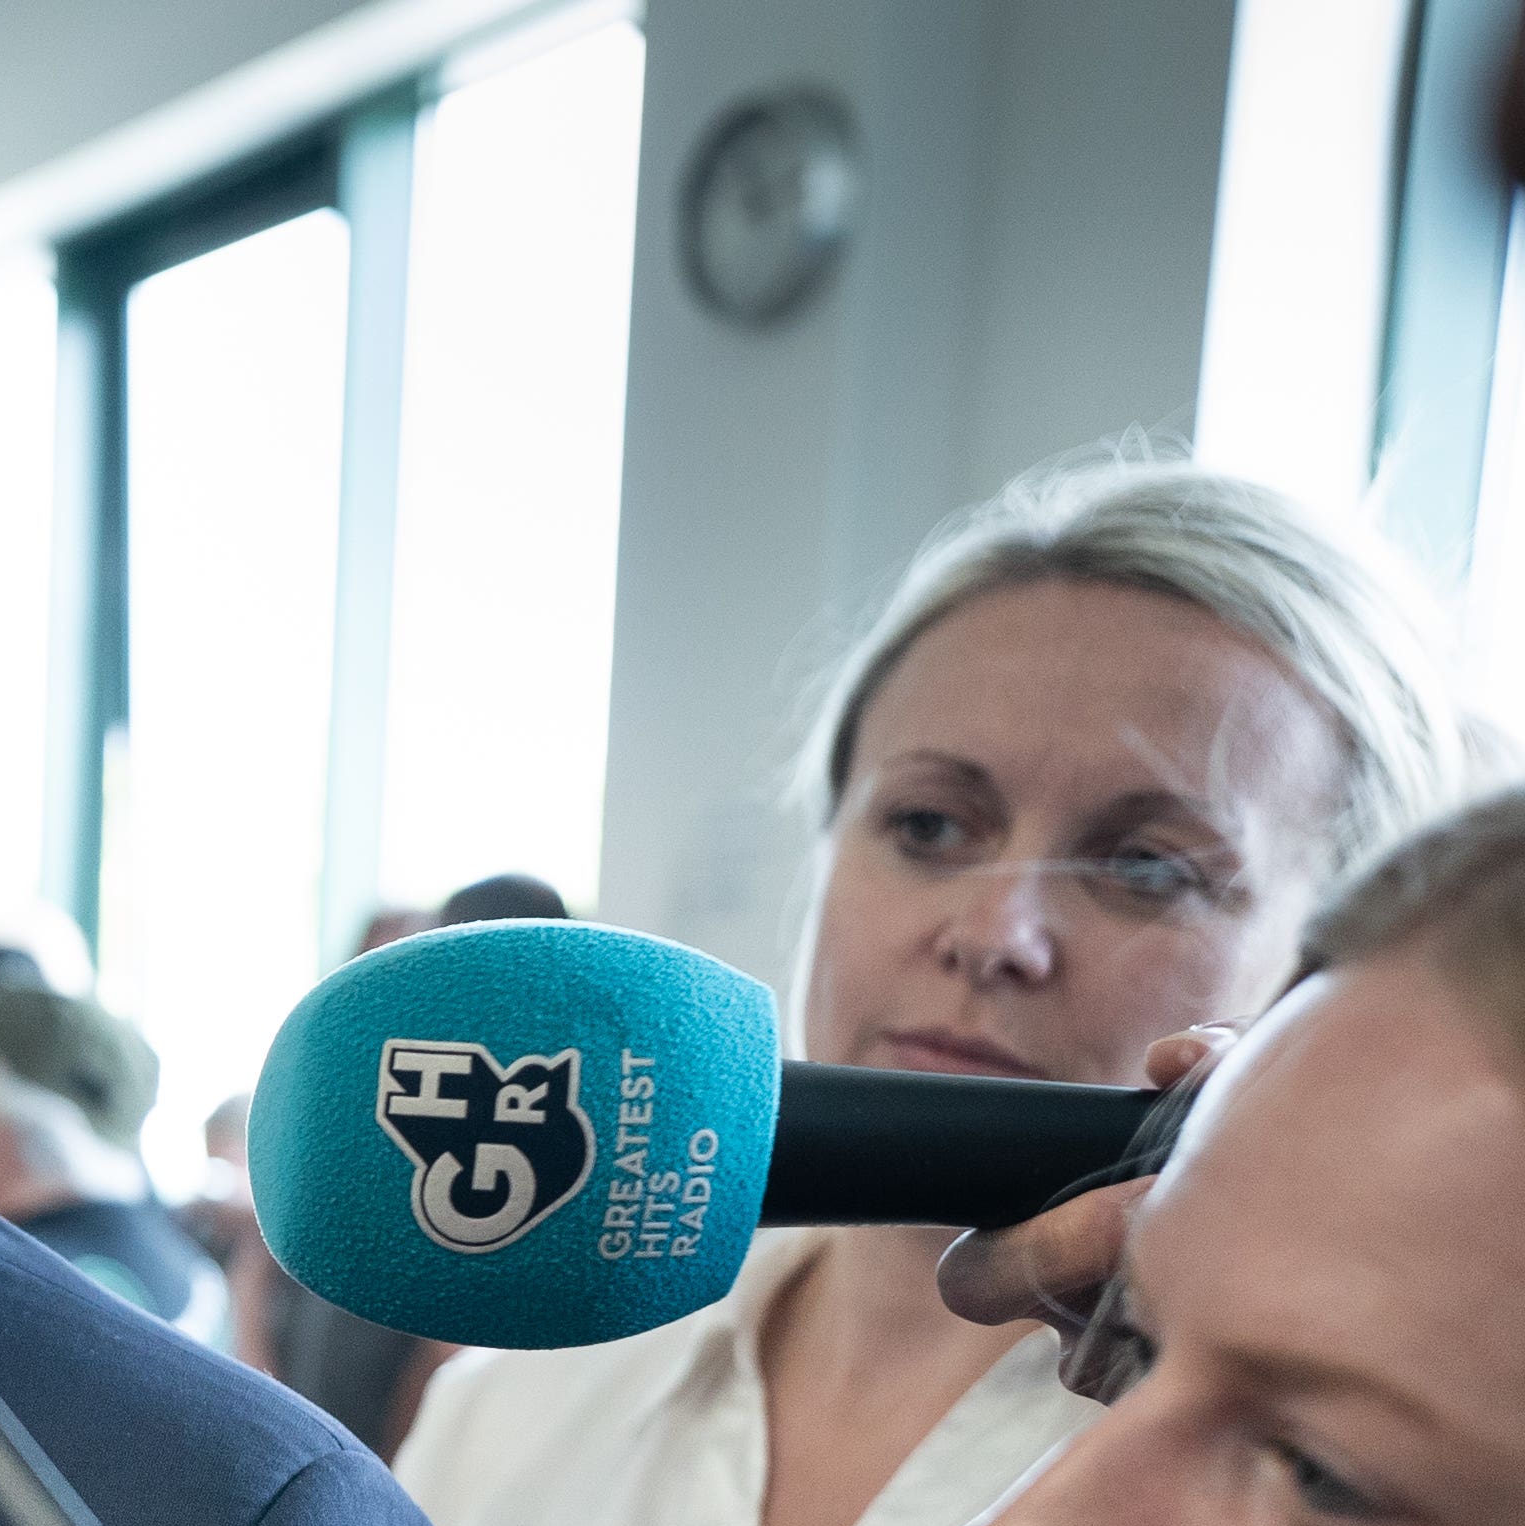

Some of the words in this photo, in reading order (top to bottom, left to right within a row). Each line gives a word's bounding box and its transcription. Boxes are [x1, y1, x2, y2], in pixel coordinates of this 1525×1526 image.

[598, 1048, 656, 1260] GREATEST
[633, 1171, 682, 1259] HITS
[670, 1128, 720, 1258] RADIO
